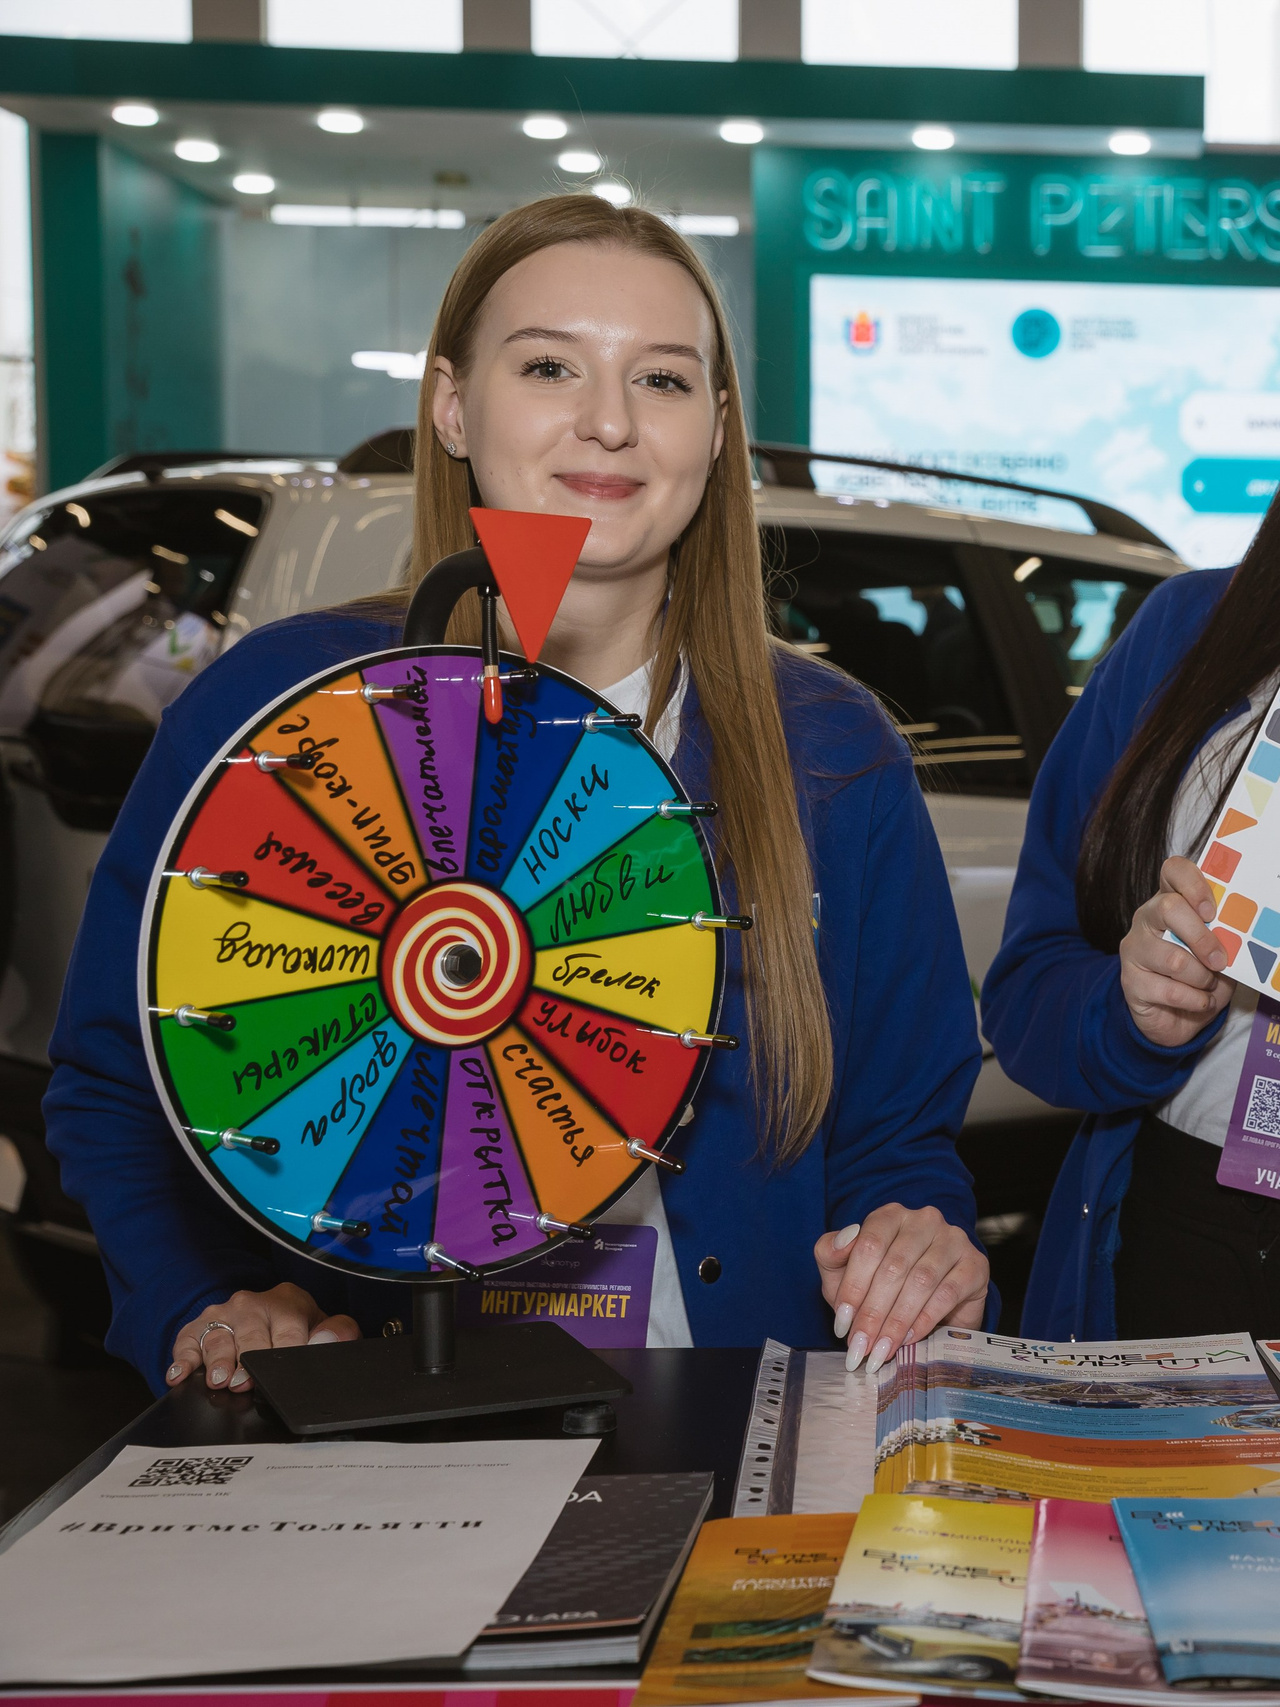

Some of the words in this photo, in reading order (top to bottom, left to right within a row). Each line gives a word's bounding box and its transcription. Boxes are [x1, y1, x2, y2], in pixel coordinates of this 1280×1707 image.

[803, 169, 1004, 253] SAINT
[213, 922, 370, 974] шоколад
[553, 953, 660, 998] брелок
[233, 993, 377, 1094] стикеры
[1265, 1048, 1273, 1057] В
[301, 1031, 397, 1147] добра
[502, 1044, 595, 1167] счастья
[460, 1058, 518, 1246] открытка
[1241, 1134, 1265, 1147] ДЕЛОВАЯ
[481, 1289, 631, 1319] ИНТУРМАРКЕТ
[1037, 1403, 1073, 1412] РАЙОН
[1166, 1437, 1247, 1445] ЦЕНТРАЛЬНЫЙ
[1054, 1463, 1092, 1472] РАЙОН
[892, 1525, 1032, 1546] #АВТОМОБИЛЬ
[525, 1610, 599, 1622] LADA
